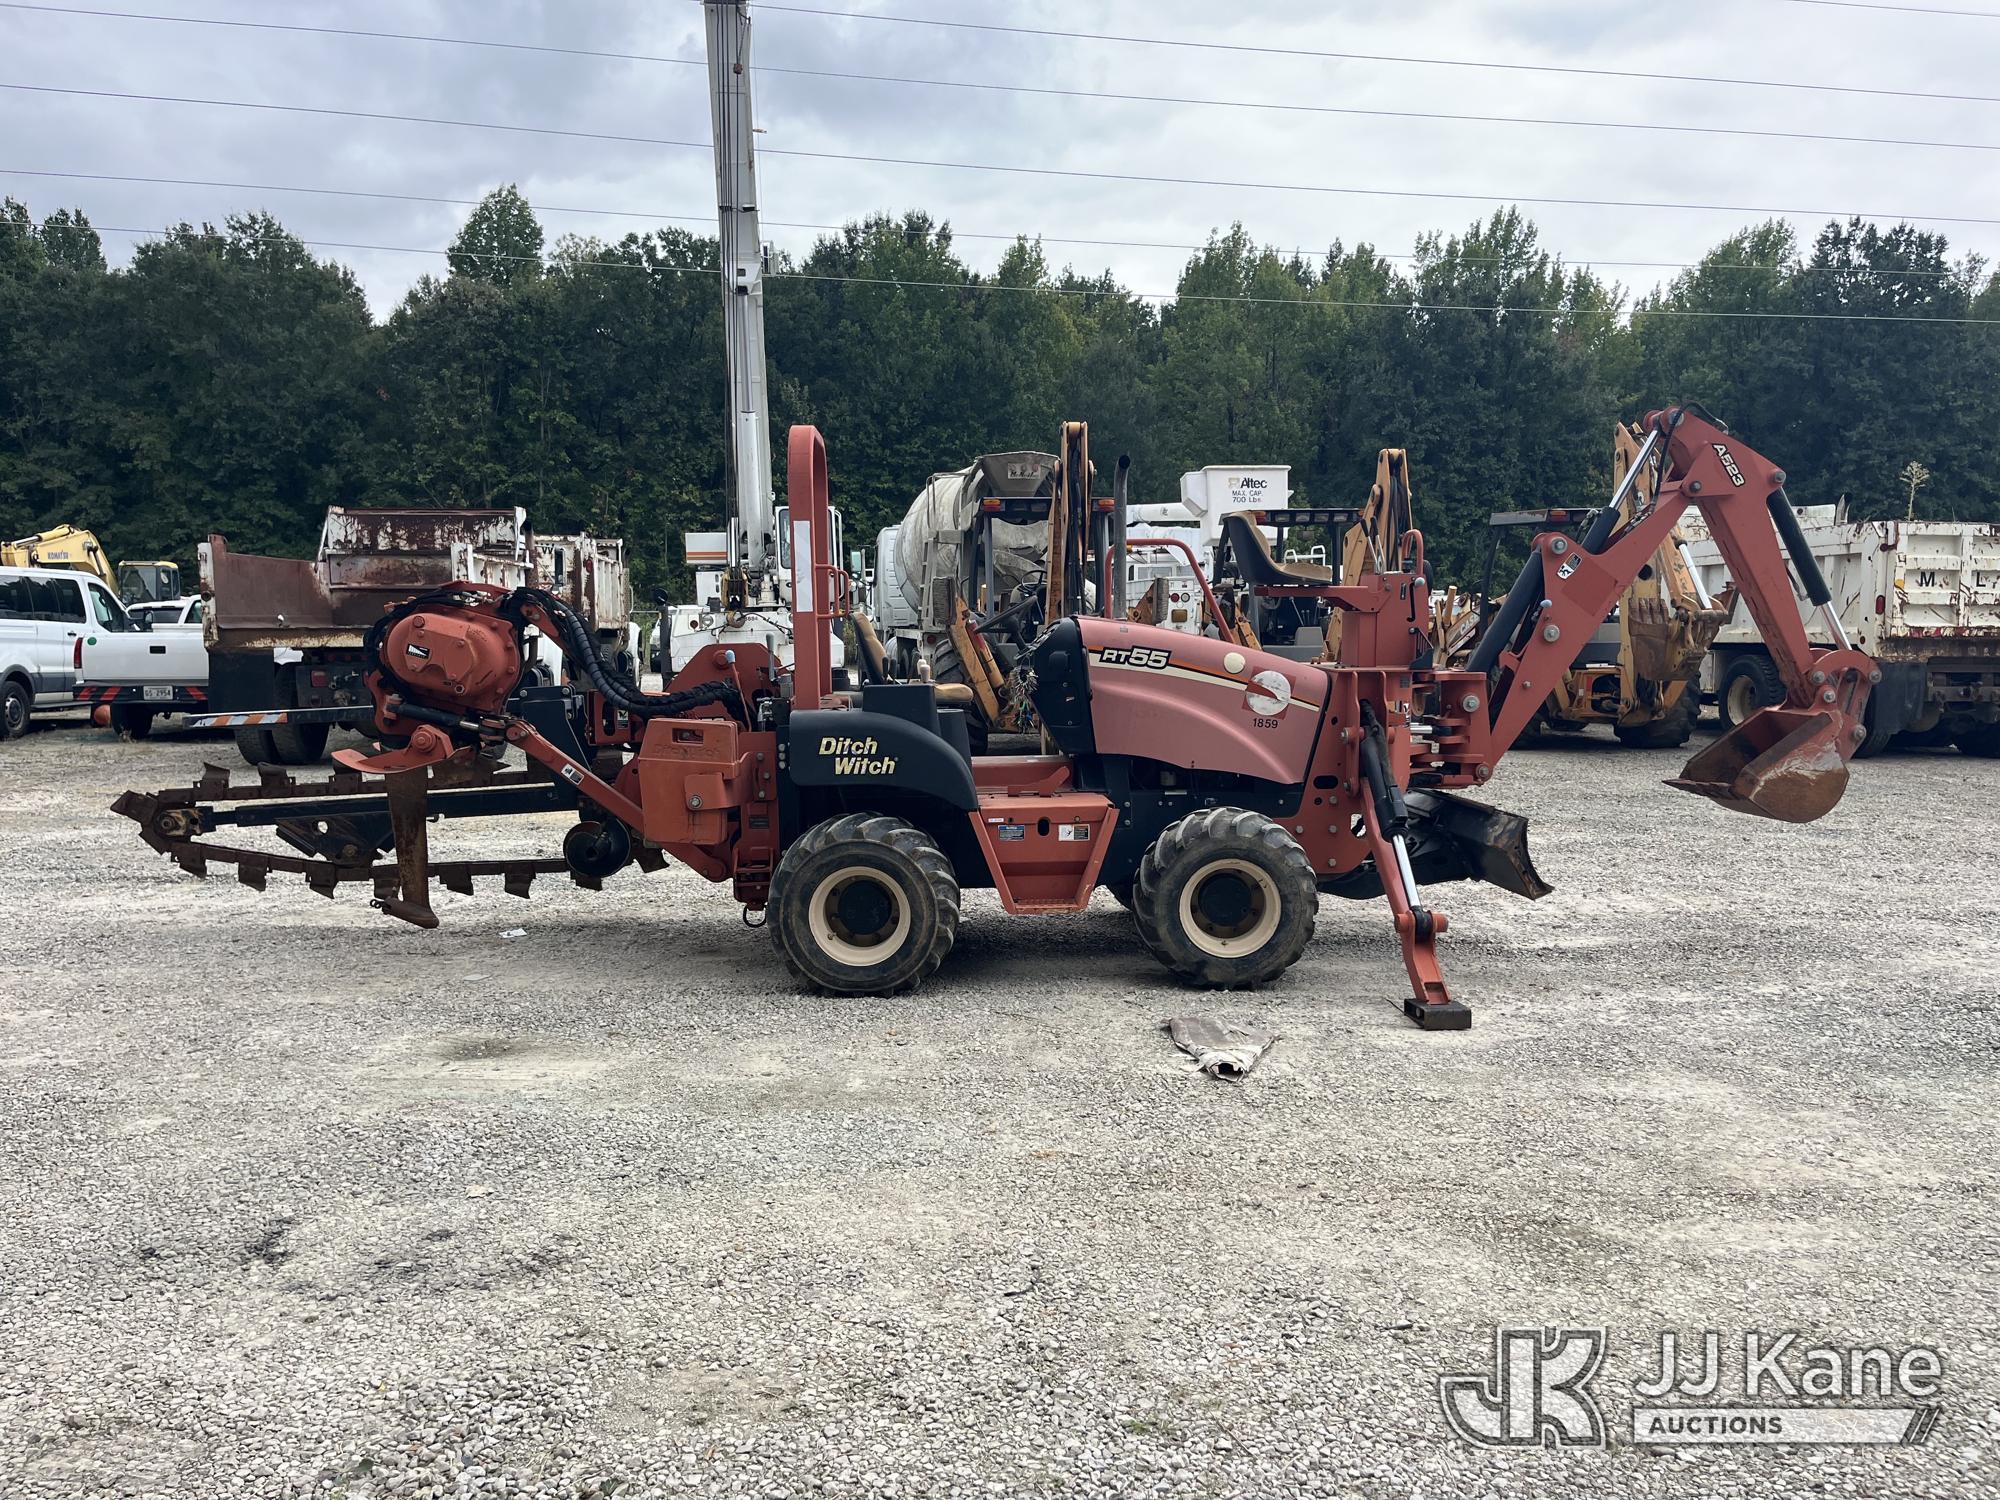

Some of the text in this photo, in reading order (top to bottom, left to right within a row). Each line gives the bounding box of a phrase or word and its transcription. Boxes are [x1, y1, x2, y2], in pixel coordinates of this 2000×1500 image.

[1712, 443, 1745, 487] A523
[1240, 477, 1268, 489] Altec
[1919, 571, 1986, 587] M L
[1101, 647, 1169, 668] RT55
[1252, 717, 1279, 729] 1859
[818, 736, 878, 756] Ditch
[834, 756, 896, 775] Witch
